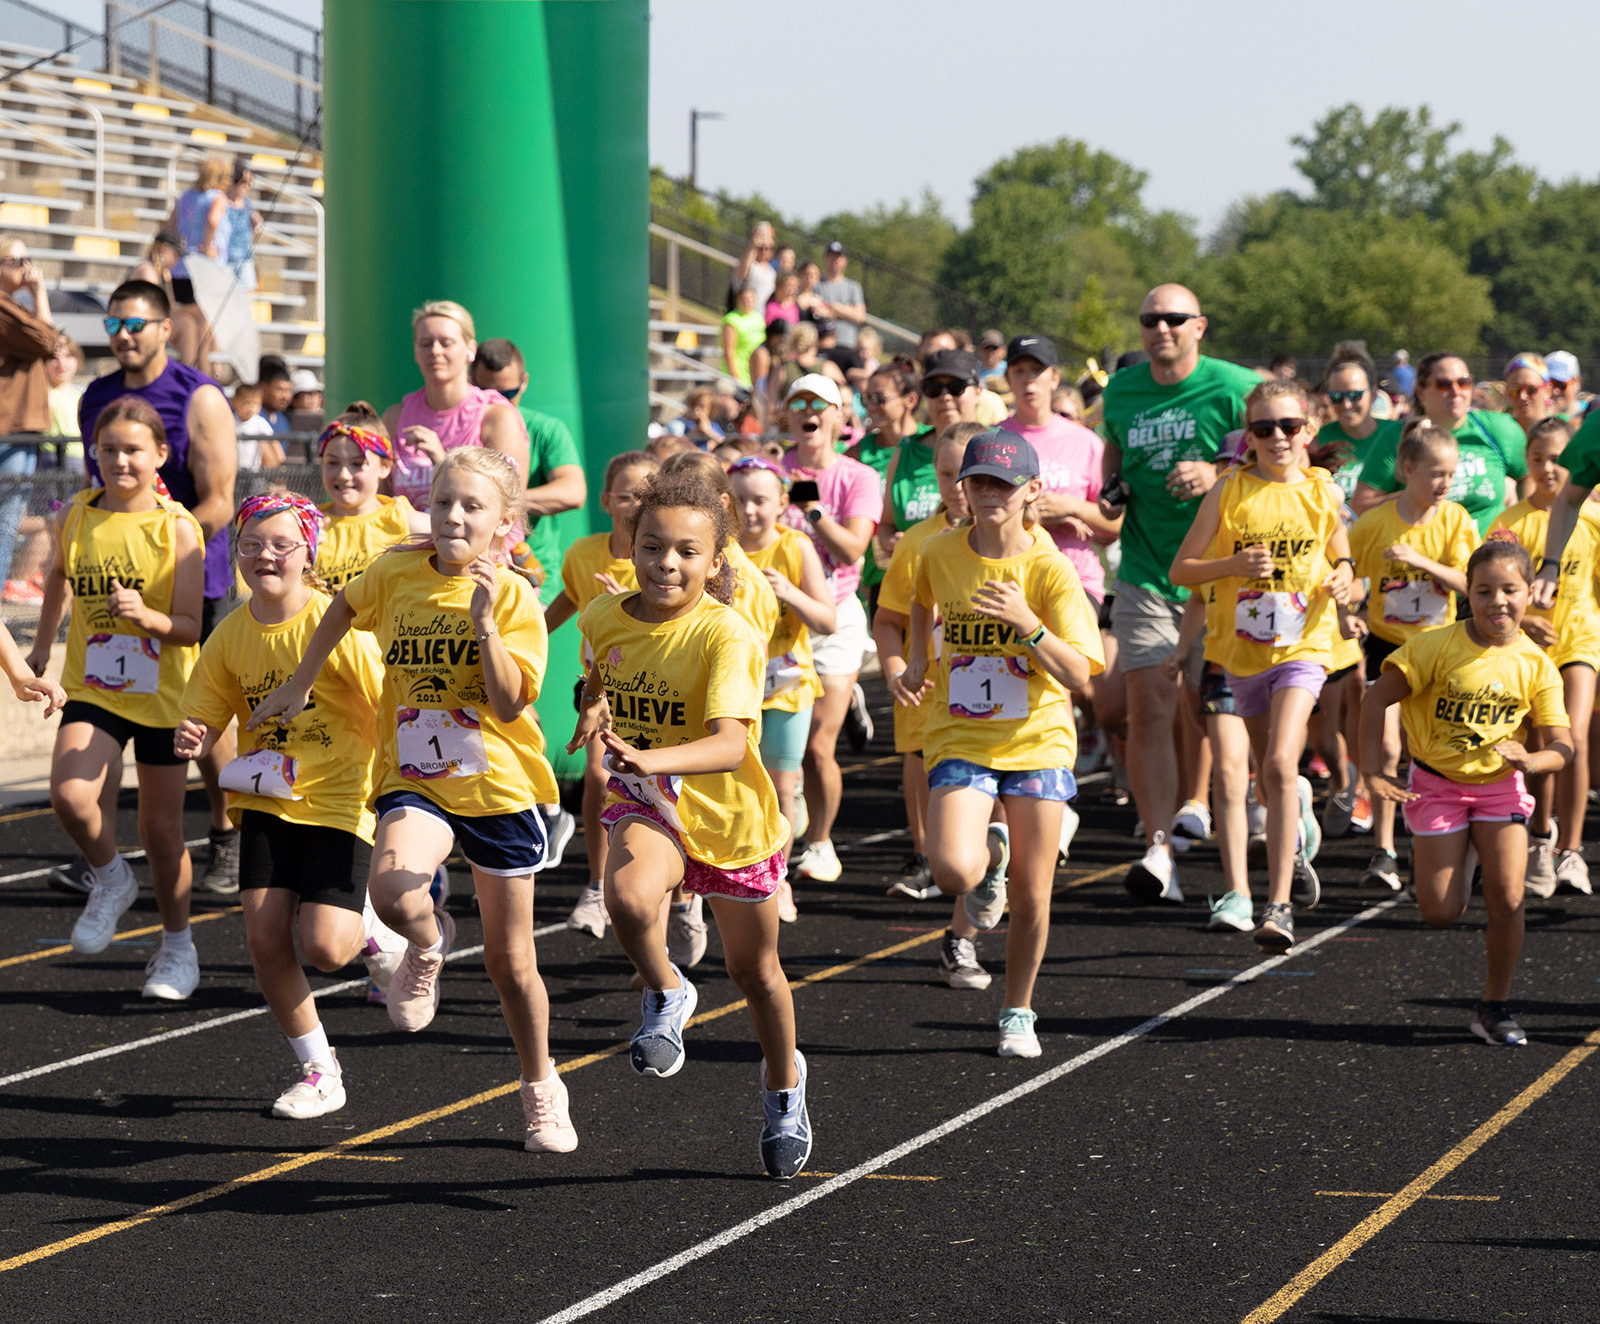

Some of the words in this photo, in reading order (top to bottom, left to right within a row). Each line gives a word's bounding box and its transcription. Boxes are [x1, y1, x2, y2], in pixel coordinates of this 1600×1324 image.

[1127, 419, 1196, 448] BELIEVE
[1412, 597, 1420, 612] 1
[398, 613, 453, 637] breathe
[456, 620, 470, 636] &
[1265, 612, 1275, 631] 1
[386, 638, 481, 667] BELIEVE
[115, 655, 126, 676] 1
[602, 663, 655, 695] breathe
[657, 680, 670, 697] &
[769, 675, 776, 688] 1
[979, 678, 992, 702] 1
[1447, 681, 1499, 701] breathe
[416, 693, 443, 704] 2023
[605, 689, 687, 727] ELIEVE
[1435, 697, 1519, 726] BELIEVE
[628, 721, 659, 735] Michigan
[427, 735, 443, 760] 1
[420, 758, 464, 771] BROMLEY
[251, 772, 263, 794] 1
